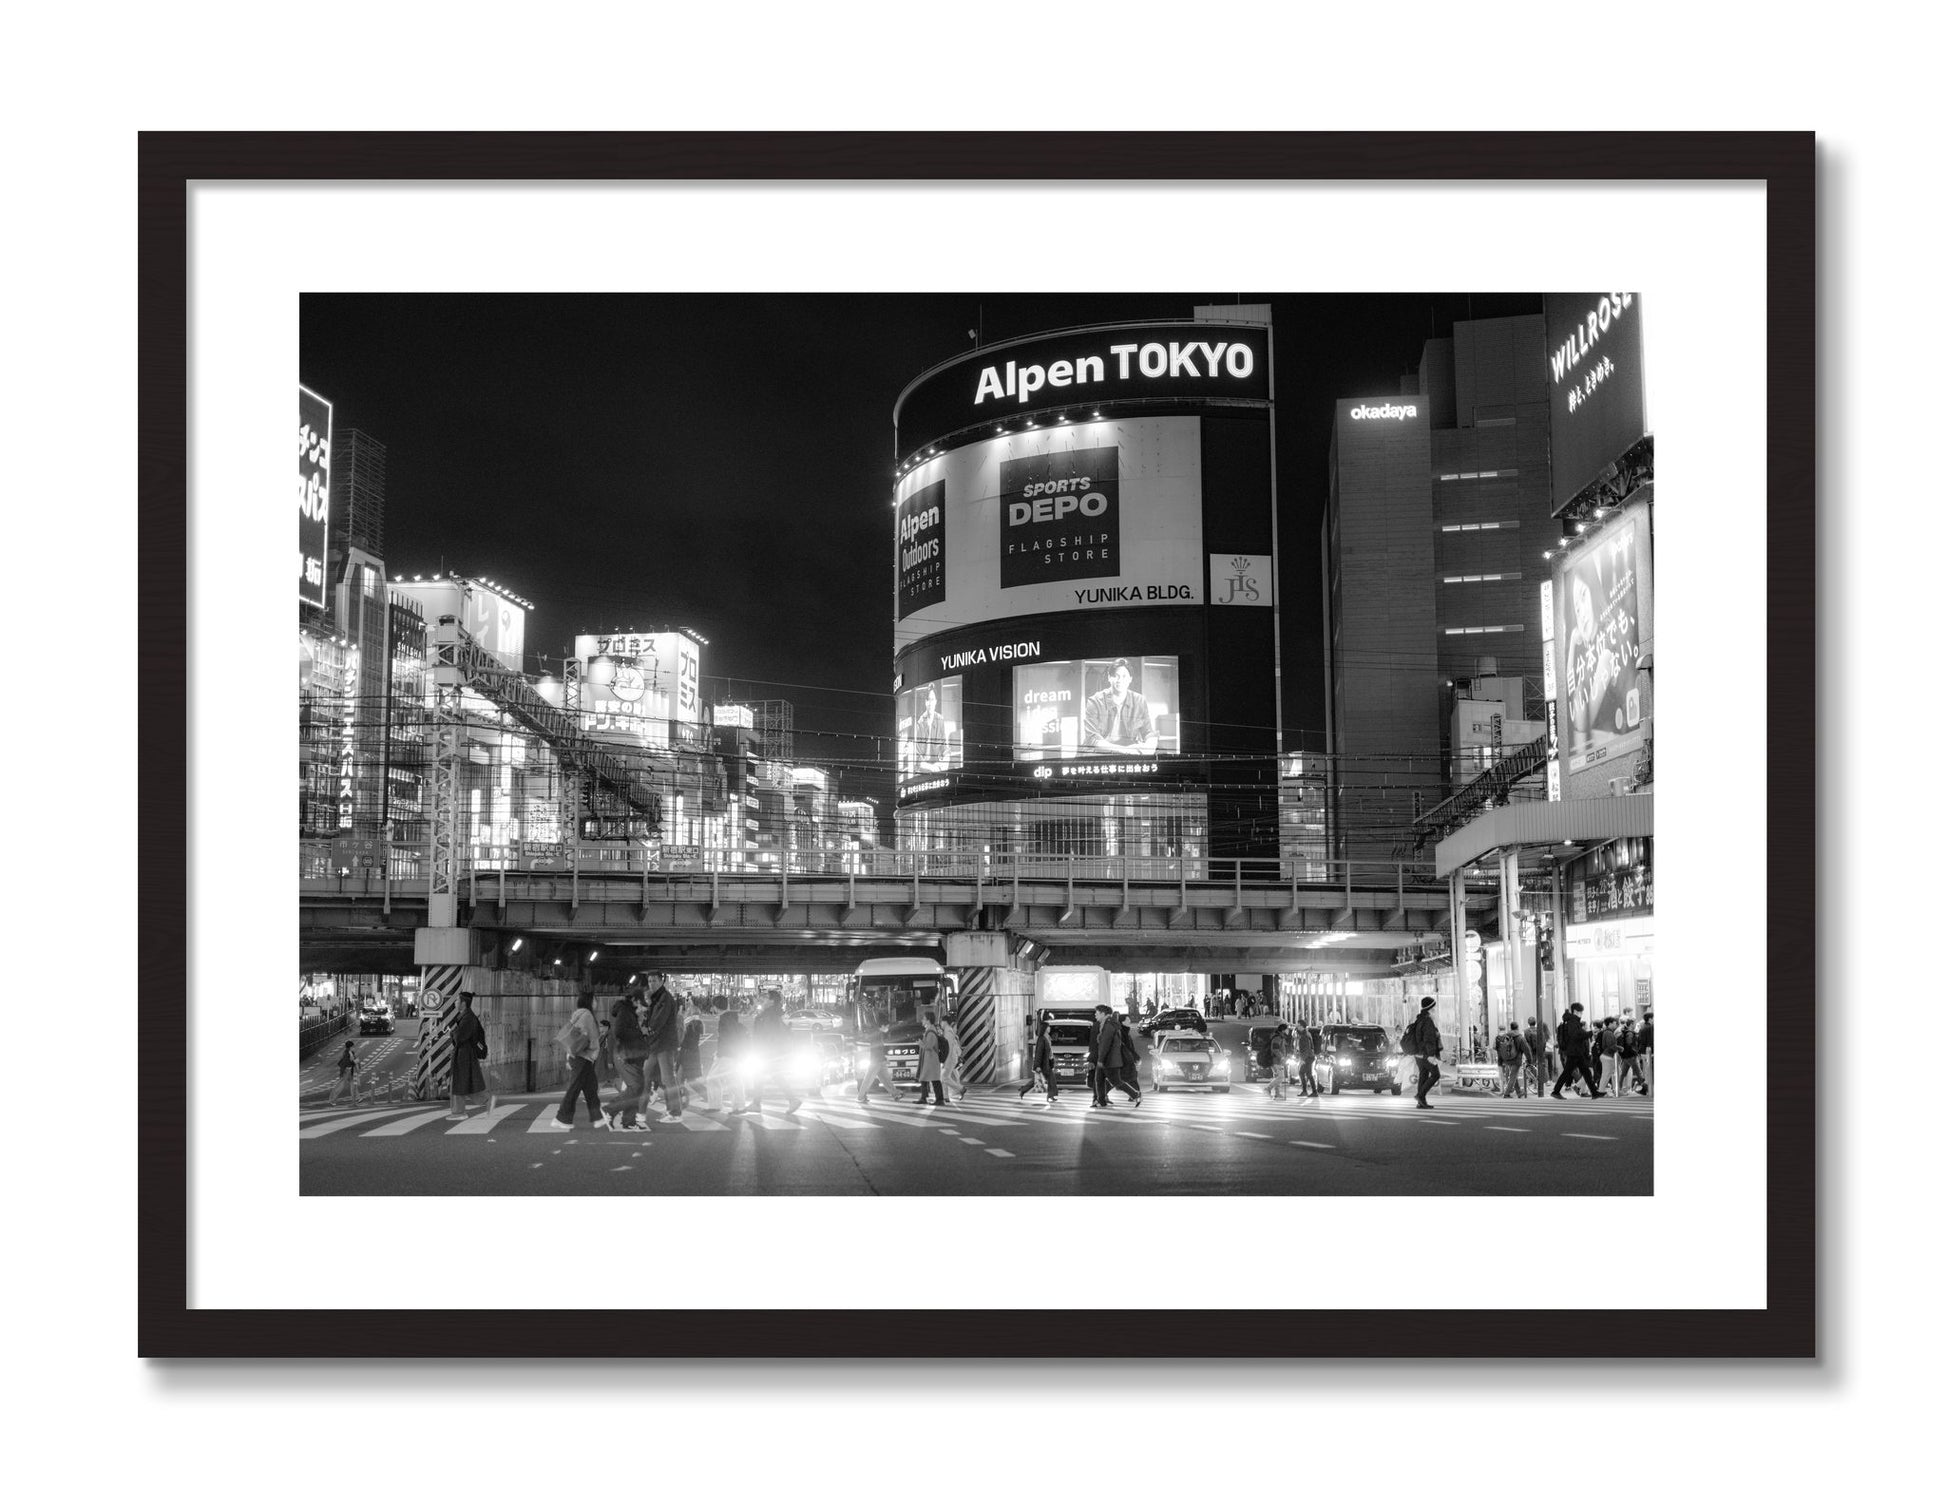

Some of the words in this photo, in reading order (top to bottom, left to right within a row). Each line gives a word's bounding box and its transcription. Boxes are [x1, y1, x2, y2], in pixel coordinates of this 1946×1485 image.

[974, 356, 1104, 404] Alpen
[1110, 342, 1254, 379] TOKYO
[1350, 404, 1417, 420] okadaya
[1023, 476, 1091, 498] SPORTS
[1008, 492, 1107, 527] DEPO
[900, 506, 940, 544] Alpen
[1008, 533, 1109, 554] FLAGSHIP
[902, 538, 939, 572] Outdoors
[1044, 549, 1109, 564] STORE
[911, 576, 940, 596] STORE
[1075, 585, 1143, 604] YUNIKA
[1146, 585, 1195, 600] BLDG.
[396, 641, 421, 658] SHISHA
[597, 637, 656, 654] プロミス
[941, 649, 986, 670] YUNIKA
[989, 641, 1040, 662] VISION
[1024, 690, 1071, 703] dream
[1034, 766, 1053, 779] dip
